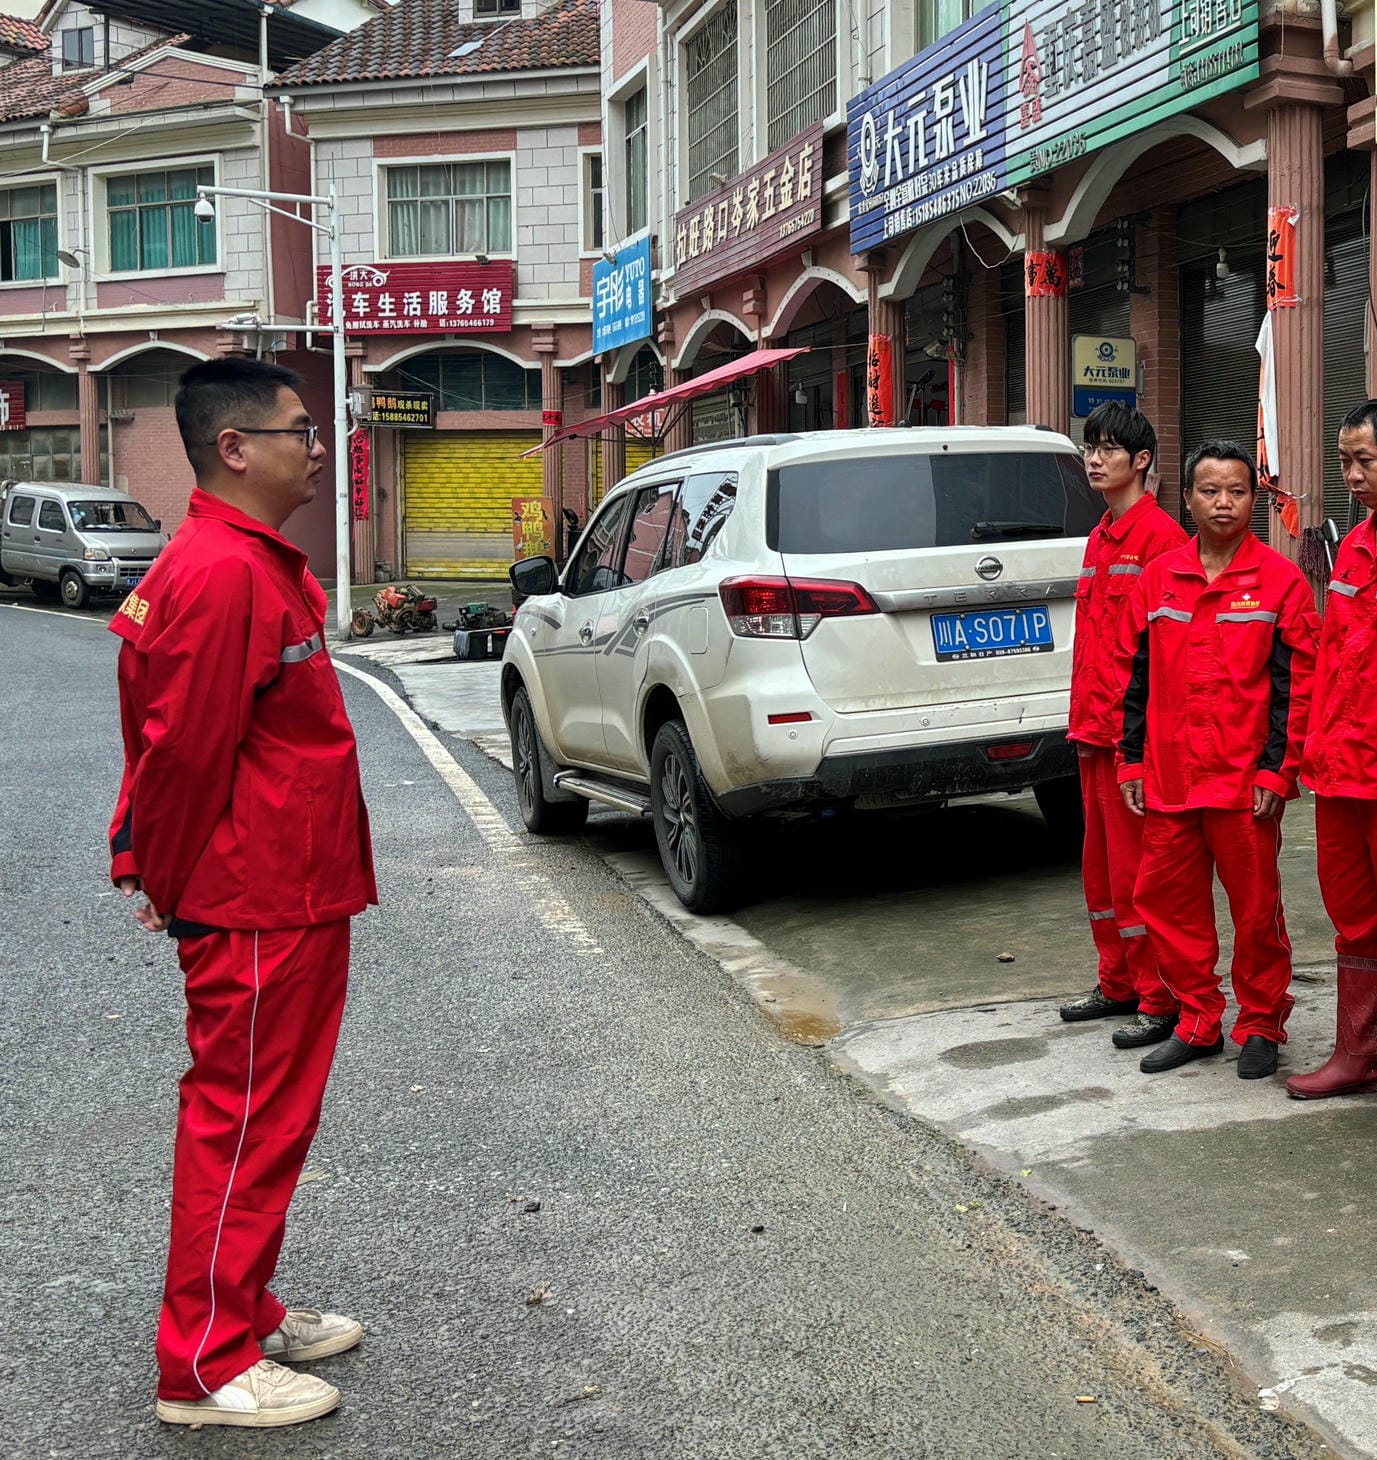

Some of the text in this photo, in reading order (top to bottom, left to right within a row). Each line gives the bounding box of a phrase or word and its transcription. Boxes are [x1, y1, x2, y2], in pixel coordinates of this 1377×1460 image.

[884, 58, 988, 187] 大元泵业
[625, 256, 645, 282] YUTO
[1083, 365, 1130, 379] 大元泵业
[923, 584, 1056, 605] TERRA
